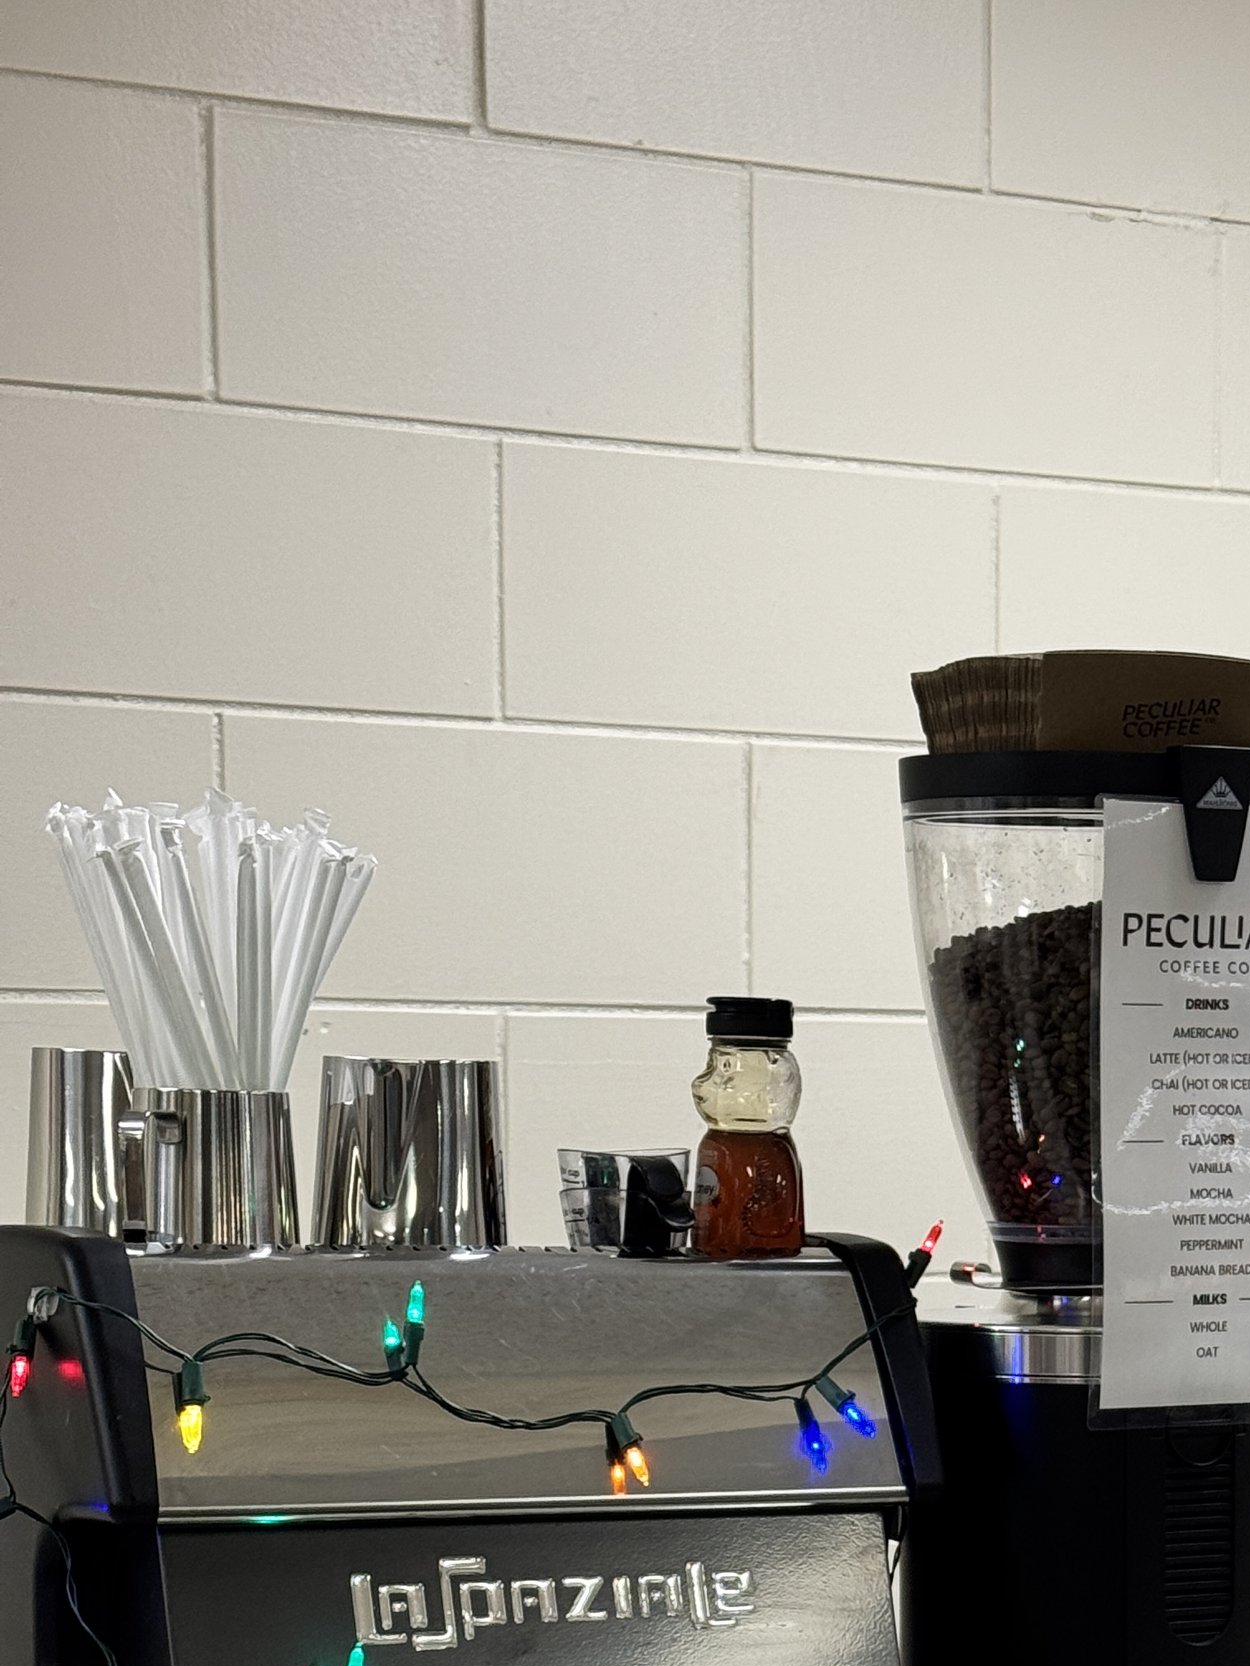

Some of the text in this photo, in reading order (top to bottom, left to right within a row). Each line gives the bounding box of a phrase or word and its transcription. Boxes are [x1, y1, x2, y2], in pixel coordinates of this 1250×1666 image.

[1122, 698, 1221, 722] PECULIAR
[1122, 718, 1202, 738] COFFEE
[1159, 960, 1221, 975] COFFEE
[1185, 998, 1230, 1010] DRINKS
[1172, 1027, 1239, 1039] AMERICANO
[1149, 1052, 1180, 1065] LATTE
[1183, 1050, 1210, 1067] (HOT
[1212, 1053, 1229, 1065] OR
[1151, 1078, 1180, 1091] CHAI
[1182, 1075, 1210, 1092] (HOT
[1212, 1079, 1229, 1091] OR
[1172, 1104, 1243, 1116] HOT COCOA
[1181, 1133, 1235, 1146] FLAVORS
[1189, 1162, 1233, 1174] VANILLA
[1190, 1188, 1234, 1199] MOCHA
[1172, 1213, 1206, 1226] WHITE
[1180, 1238, 1244, 1251] PEPPERMINT
[1170, 1265, 1216, 1277] BANANA
[1192, 1293, 1228, 1305] MILKS
[1190, 1321, 1228, 1333] WHOLE
[1196, 1346, 1219, 1358] OAT
